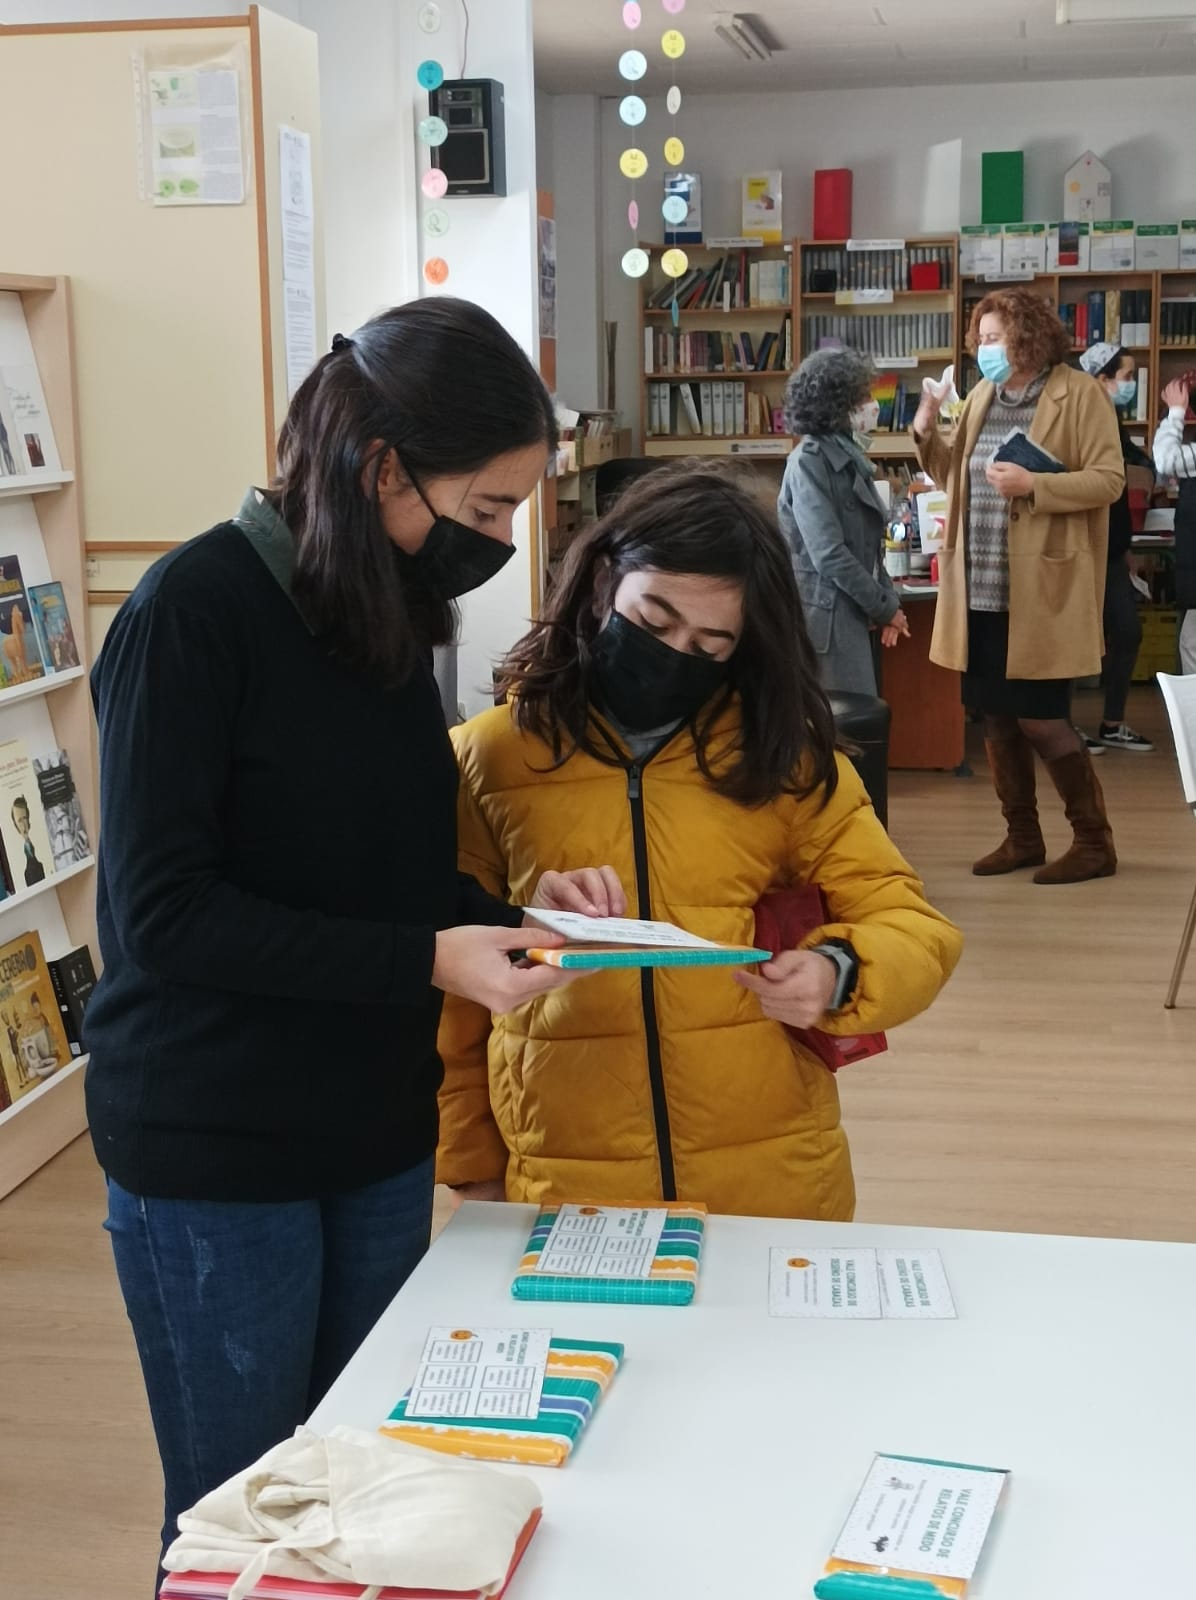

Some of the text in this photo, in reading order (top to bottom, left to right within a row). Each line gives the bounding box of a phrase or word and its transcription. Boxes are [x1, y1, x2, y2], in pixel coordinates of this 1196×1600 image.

[918, 1488, 953, 1552] RELATOS DE MEDO
[936, 1488, 973, 1558] VALE CONCURSO DE
